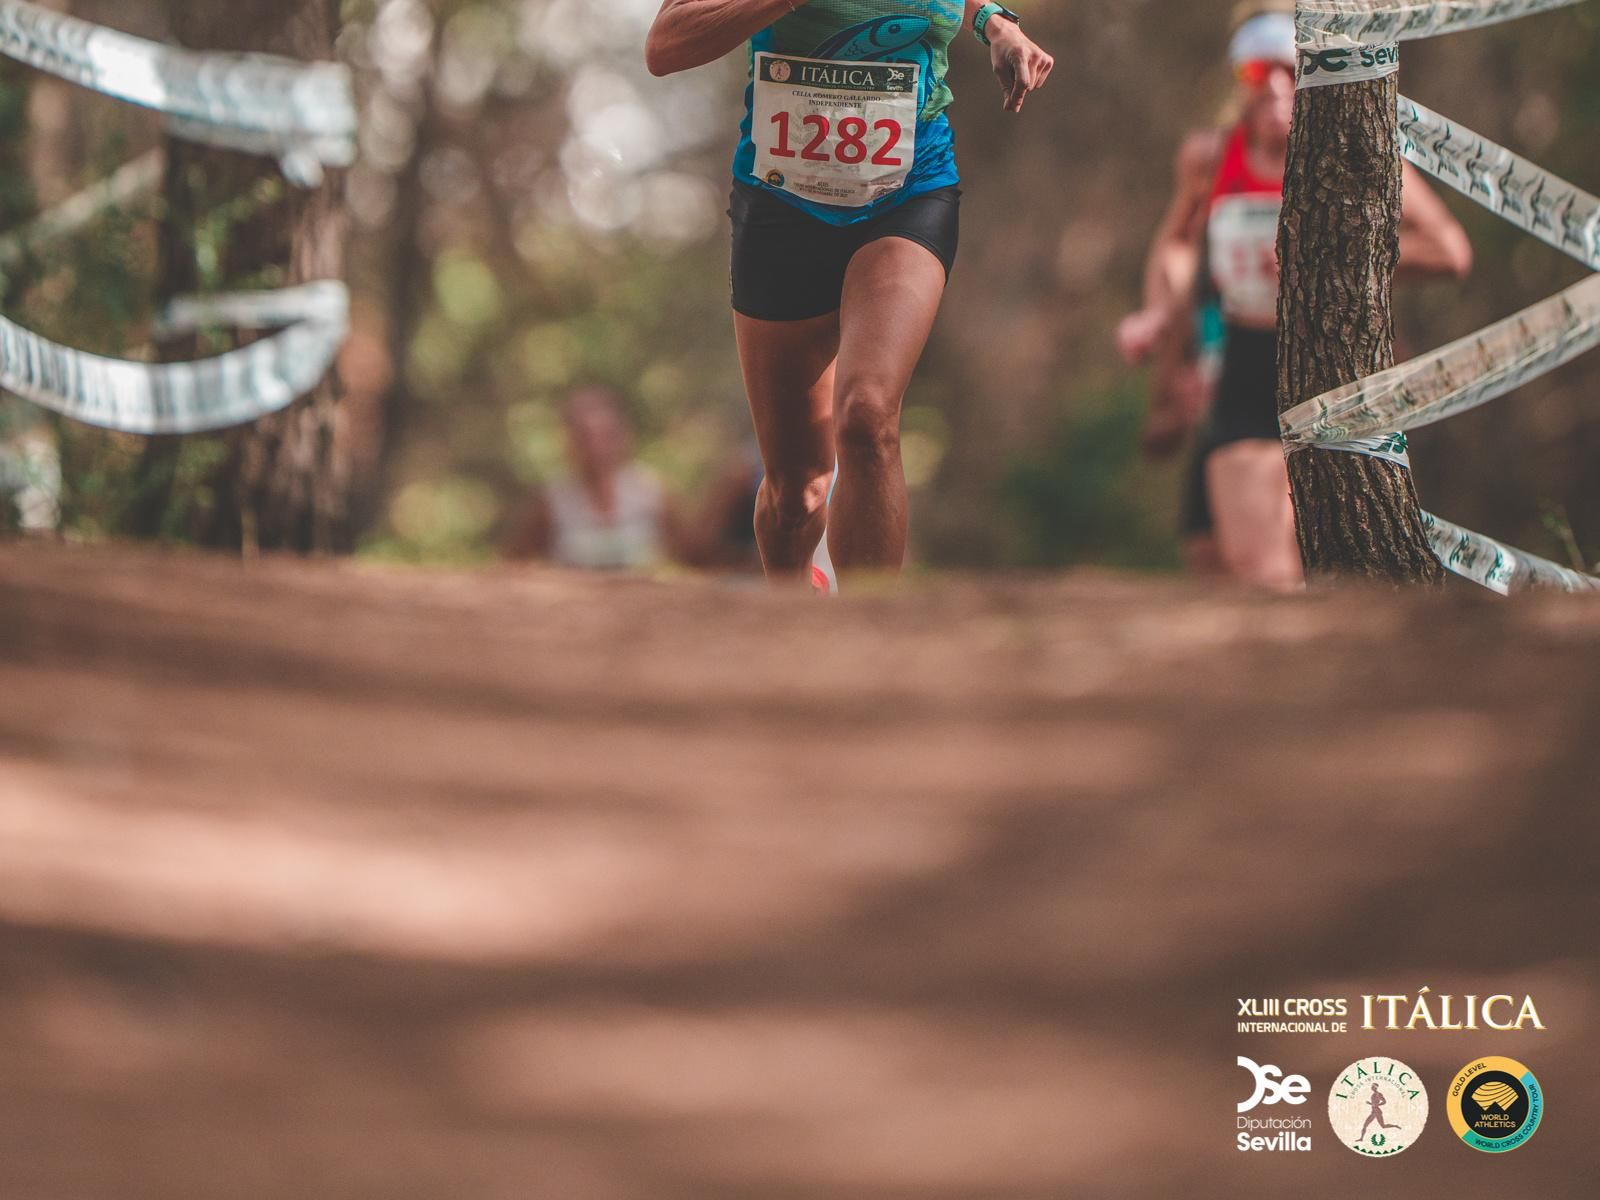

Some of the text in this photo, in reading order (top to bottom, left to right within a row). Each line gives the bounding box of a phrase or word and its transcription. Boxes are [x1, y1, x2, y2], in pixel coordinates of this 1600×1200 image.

[801, 64, 875, 86] ITÁLICA
[792, 90, 812, 98] CELIA
[843, 94, 881, 102] GALLARDO
[808, 100, 862, 108] INDEPENDIENTE
[769, 111, 902, 166] 1282
